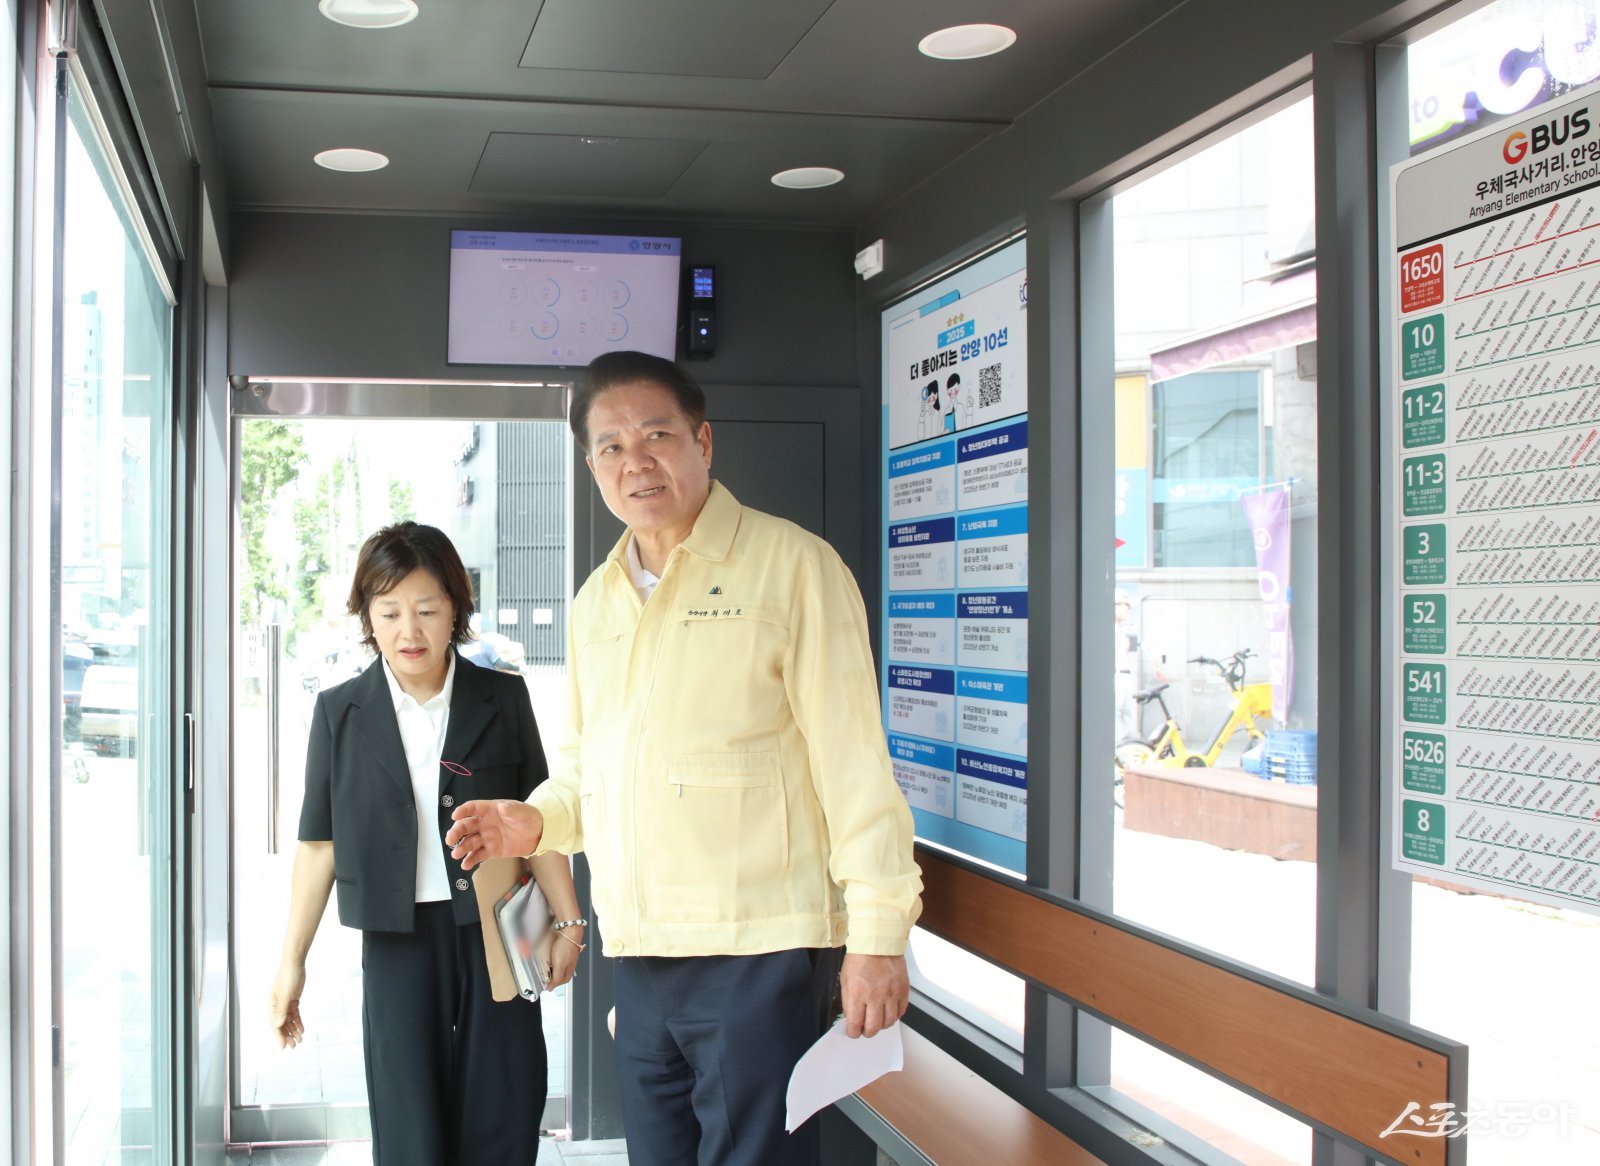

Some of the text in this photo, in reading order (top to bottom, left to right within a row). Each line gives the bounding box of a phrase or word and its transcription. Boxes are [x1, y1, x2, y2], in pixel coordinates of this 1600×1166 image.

[1469, 199, 1503, 219] Anyang
[1505, 180, 1561, 207] Elementary
[642, 241, 672, 251] 안양시
[1402, 252, 1442, 284] 1650
[946, 326, 965, 343] 2025
[1412, 323, 1435, 349] 10
[910, 327, 1009, 380] 더 좋아지는 안양 10선
[1405, 391, 1443, 419] 11-2
[1405, 461, 1444, 487] 11-3
[1418, 532, 1430, 554] 3
[1413, 601, 1436, 624] 52
[1409, 670, 1441, 693] 541
[1404, 738, 1444, 764] 5626
[1417, 809, 1430, 831] 8
